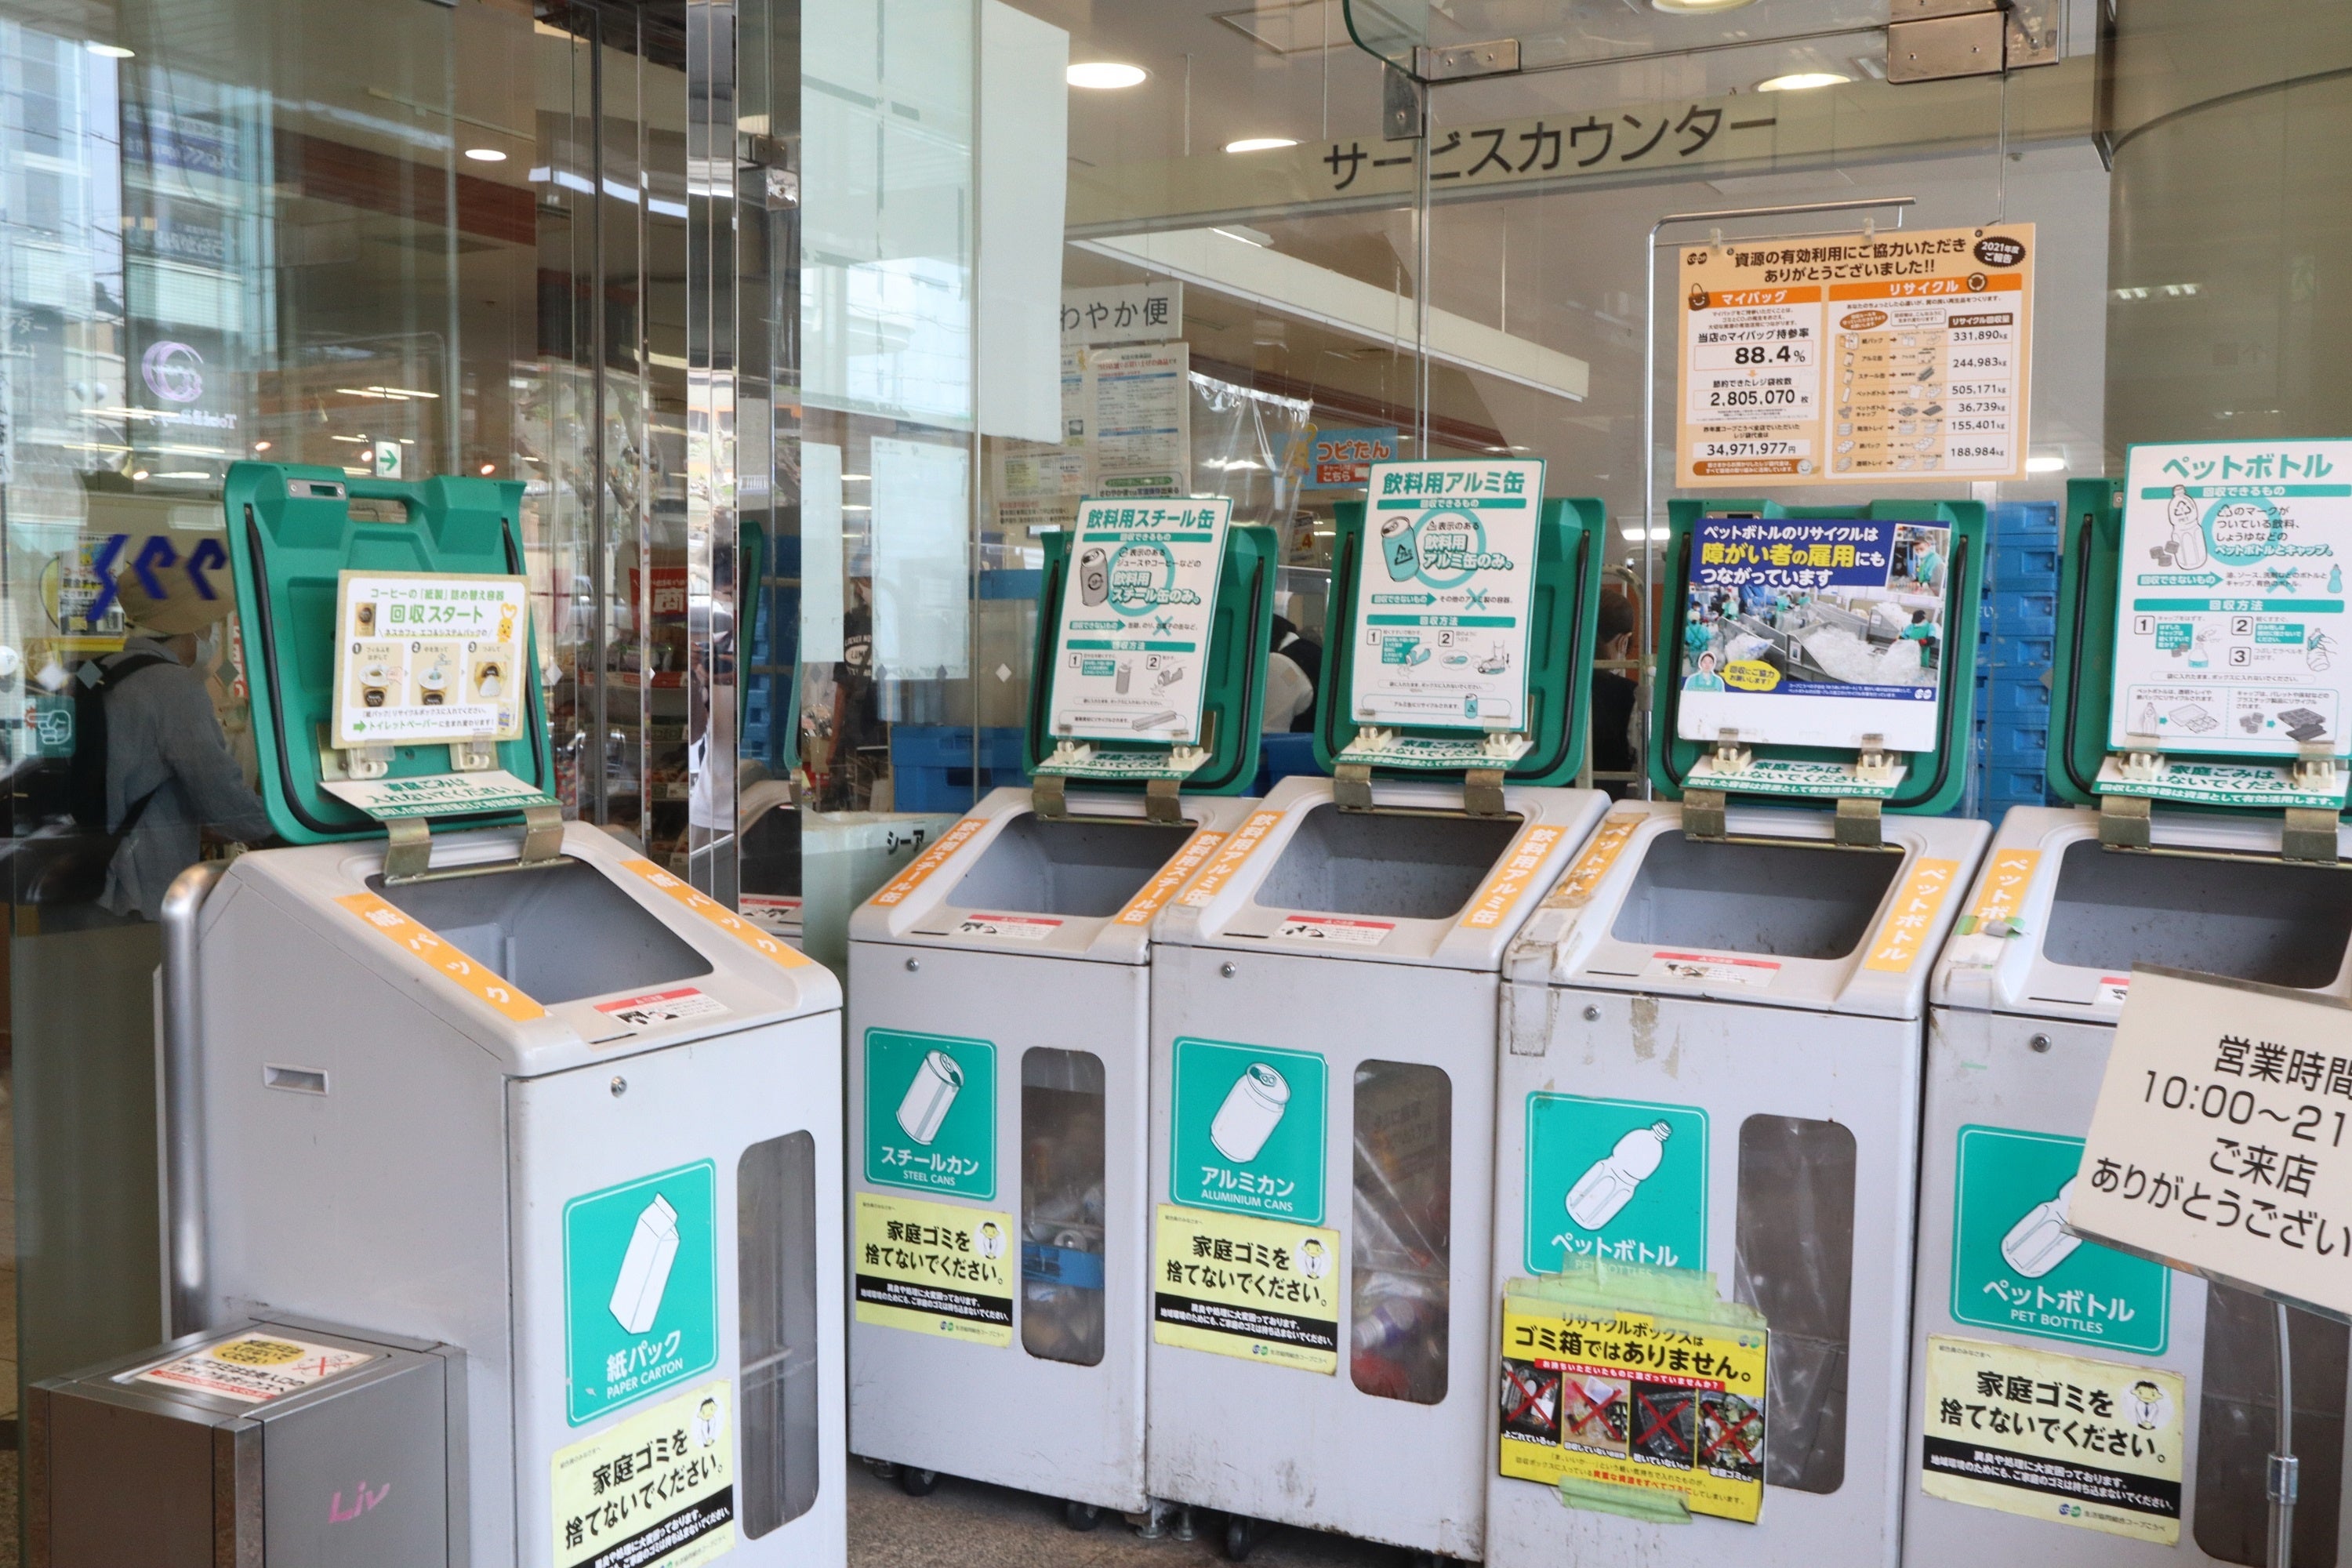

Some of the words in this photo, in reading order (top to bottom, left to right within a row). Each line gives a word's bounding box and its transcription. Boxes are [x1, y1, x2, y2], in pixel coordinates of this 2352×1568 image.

[1323, 104, 1776, 190] サービスカウンター
[1735, 238, 1965, 267] 資源の有効利用にご協力いただき
[1981, 241, 2020, 254] 2021年度
[1984, 252, 2013, 264] ご報告
[1722, 290, 1788, 305] マイバッグ
[1889, 280, 1959, 296] リサイクル
[1953, 316, 2010, 325] リサイクル回収量
[1698, 328, 1809, 343] 当店のマイバッグ持参率
[1713, 377, 1792, 388] 節約できたレジ袋枚数
[1317, 440, 1389, 462] コピたん
[1323, 472, 1350, 481] こちら
[2162, 454, 2333, 481] ペットボトル
[1382, 471, 1524, 495] 飲料用アルミ缶
[2203, 485, 2285, 496] 回収できるもの
[1420, 499, 1479, 508] 回収できるもの
[1086, 508, 1214, 529] 飲料用スチール缶
[1438, 521, 1479, 531] 表示のある
[1424, 534, 1468, 552] 飲料用
[1703, 524, 1878, 542] ペットボトルのリサイクルは
[2216, 532, 2288, 542] しょうゆなどの
[1700, 543, 1885, 568] 障がい者の雇用にも
[2215, 543, 2333, 557] ペットボトルとキャップ。
[1423, 552, 1514, 570] アルミ缶のみ。
[1112, 571, 1152, 588] 飲料用
[1700, 568, 1833, 587] つながっています
[2140, 575, 2216, 586] 回収できないもの
[1112, 587, 1201, 604] スチール缶のみ。
[2209, 600, 2263, 611] 回収方法
[390, 604, 483, 623] 回収スタート
[1419, 616, 1458, 626] 回収方法
[2237, 619, 2248, 631] 2
[2234, 651, 2245, 662] 3
[1730, 665, 1775, 679] 回収にご協力
[1755, 761, 1843, 774] 家庭ごみは
[2169, 765, 2275, 779] 家庭ごみは
[887, 829, 924, 855] シーア
[1471, 828, 1559, 925] 飲料用アルミ缶
[1978, 858, 2028, 931] ペットボ
[1877, 869, 1947, 960] ペットボトル
[2214, 1034, 2352, 1100] 営業時間
[881, 1146, 979, 1176] スチールカン
[2210, 1137, 2318, 1198] ご来店
[903, 1170, 928, 1182] STEEL
[931, 1173, 956, 1186] CANS
[1201, 1166, 1294, 1197] アルミカン
[1201, 1191, 1261, 1207] ALUMINIUM
[1264, 1199, 1293, 1212] CANS
[2092, 1157, 2350, 1257] ありがとうござい
[887, 1220, 970, 1252] 家庭ゴミを
[1192, 1235, 1290, 1272] 家庭ゴミを
[1552, 1232, 1679, 1268] ペットボトル
[866, 1243, 1003, 1285] 捨てないでください。
[1167, 1259, 1327, 1306] 捨てないでください。
[1983, 1279, 2135, 1322] ペットボトル
[1563, 1312, 1704, 1347] リサイクルボックスは
[2010, 1308, 2036, 1323] PET
[2041, 1315, 2103, 1334] BOTTLES
[607, 1329, 681, 1382] 紙パック
[1515, 1325, 1751, 1382] ゴミ箱ではありません。
[607, 1378, 638, 1399] PAPER
[641, 1358, 684, 1385] CARTON
[1976, 1371, 2114, 1418] 家庭ゴミを
[1940, 1397, 2165, 1464] 捨てないでください。
[593, 1428, 688, 1496] 家庭ゴミを
[565, 1454, 723, 1549] 捨てないでください。
